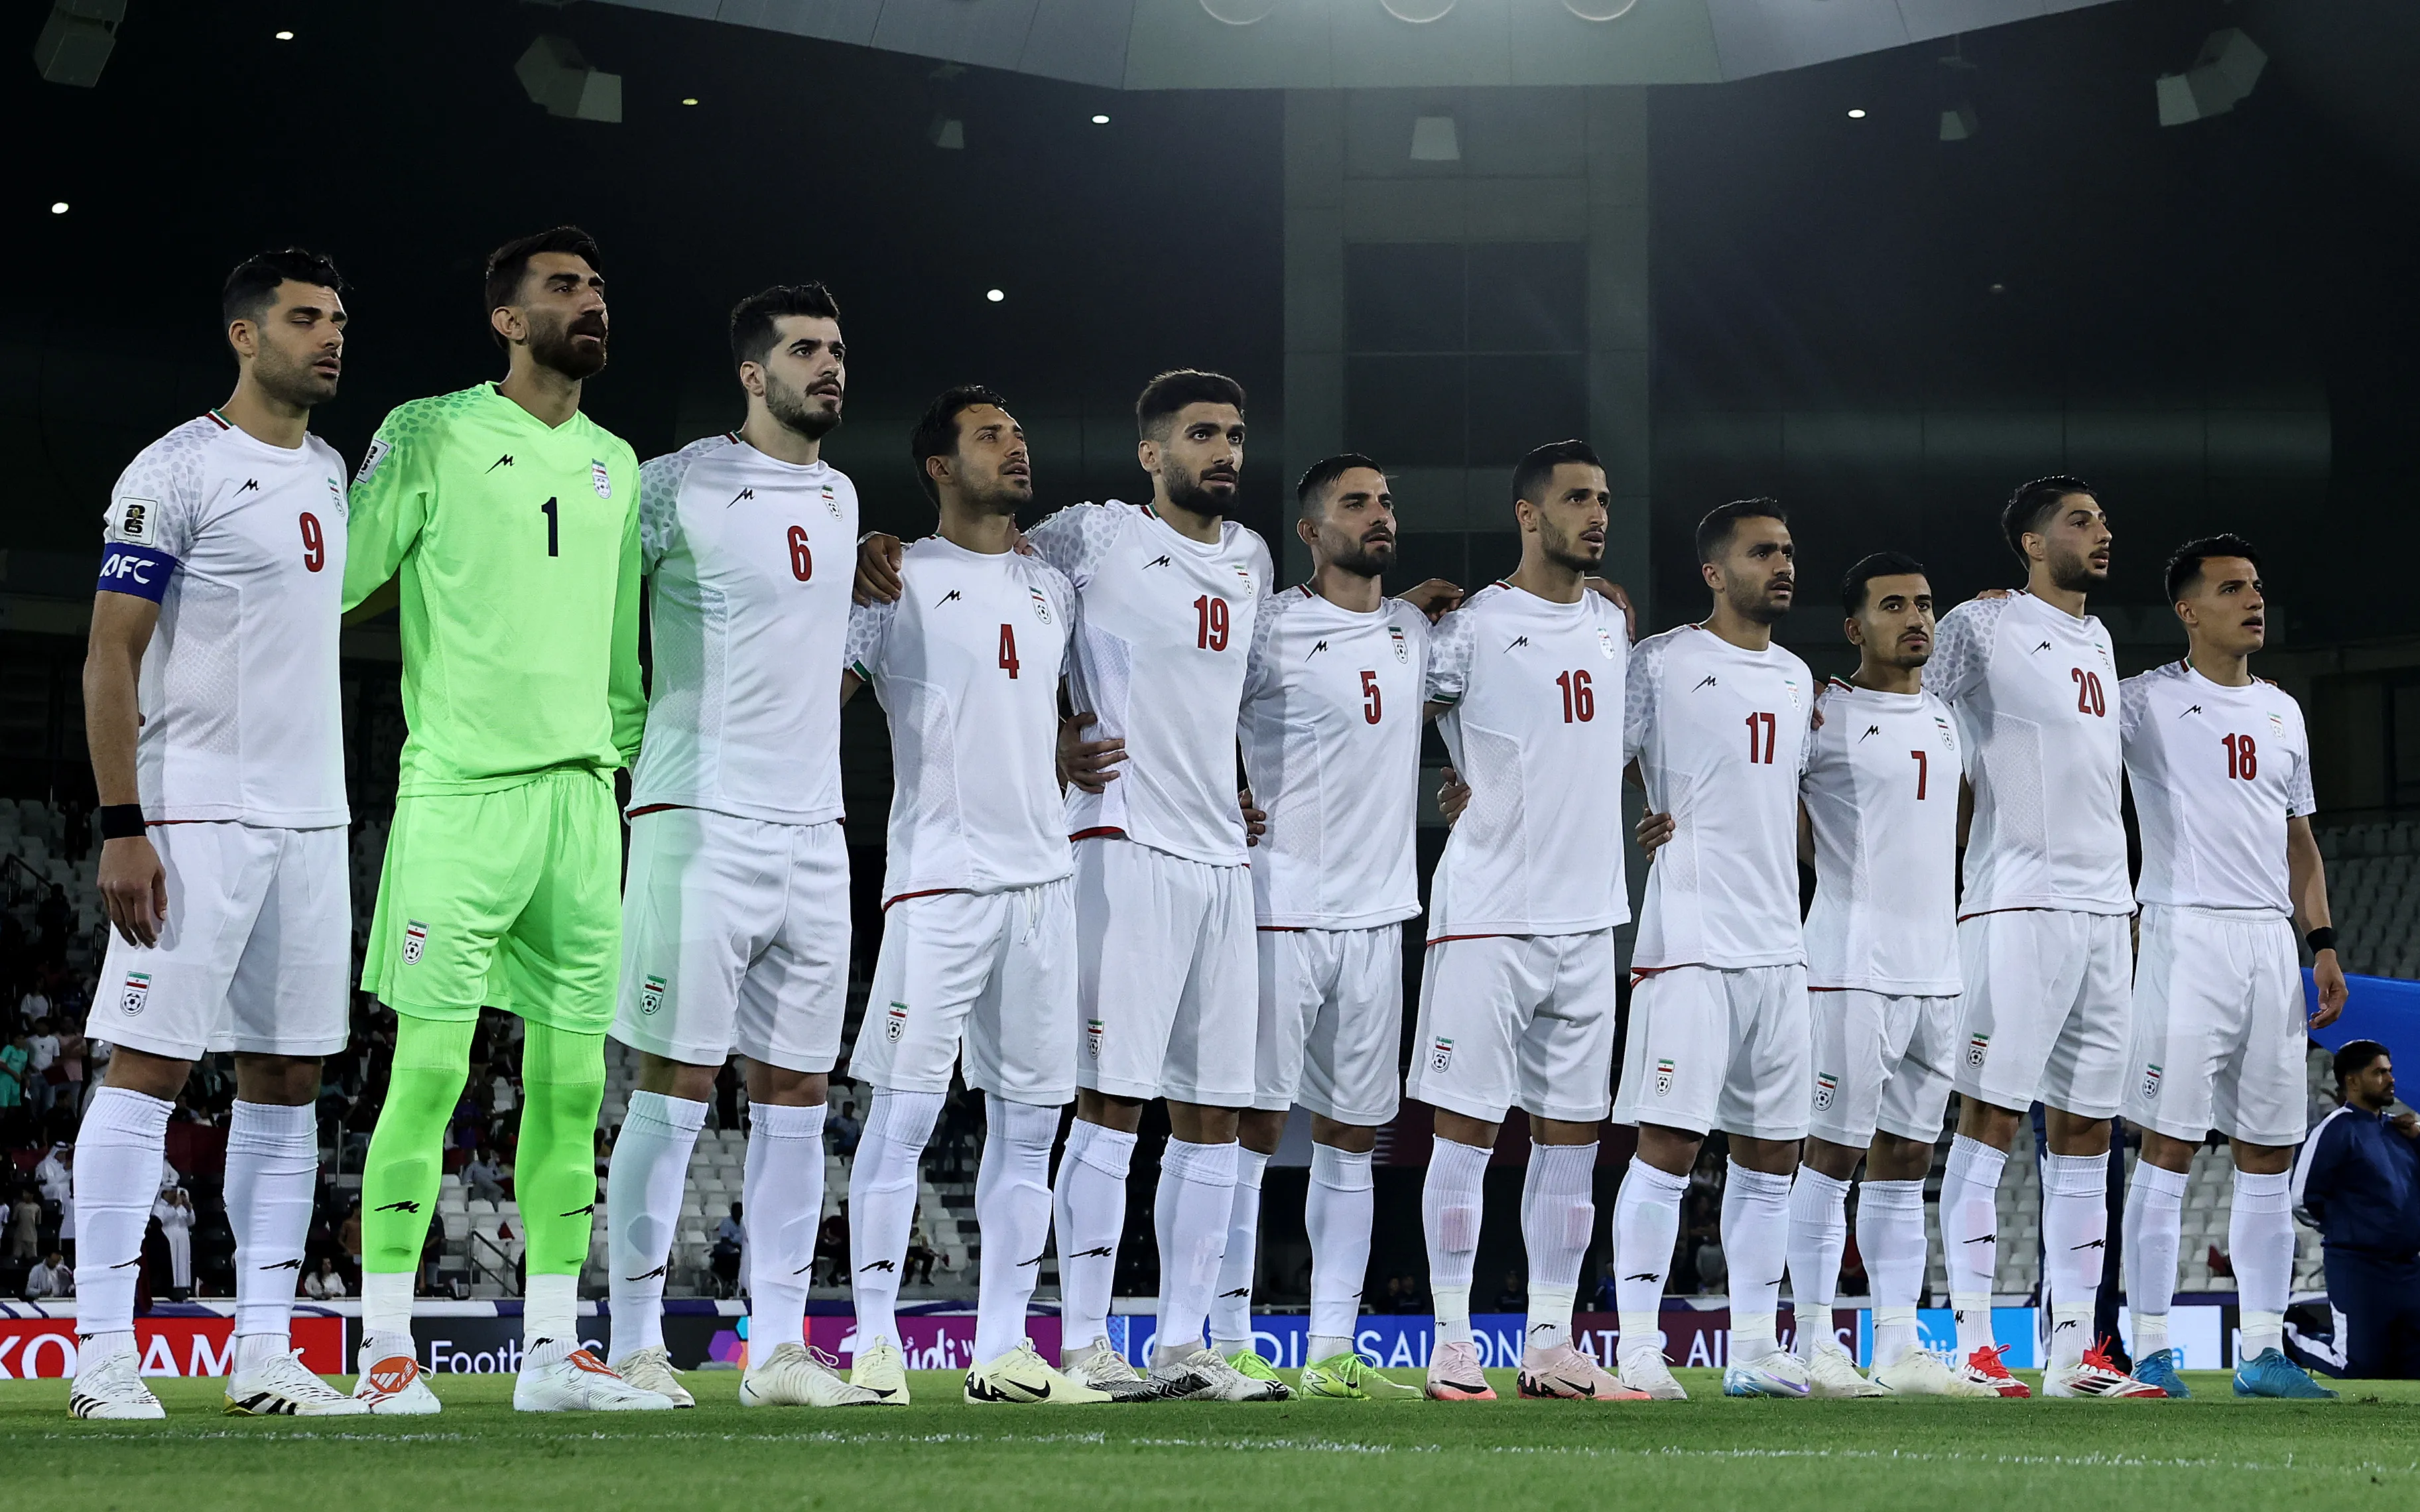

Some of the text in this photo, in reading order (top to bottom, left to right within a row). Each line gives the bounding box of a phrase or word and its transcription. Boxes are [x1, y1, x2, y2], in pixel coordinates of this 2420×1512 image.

[300, 512, 324, 572] 9
[541, 496, 559, 558] 1
[787, 525, 812, 582] 6
[99, 554, 155, 584] AFC
[1194, 595, 1230, 652] 19
[999, 624, 1019, 680] 4
[1360, 670, 1381, 725] 5
[1556, 670, 1594, 724] 16
[2072, 668, 2105, 718] 20
[1746, 712, 1776, 765] 17
[2221, 733, 2256, 781] 18
[1910, 750, 1927, 800] 7
